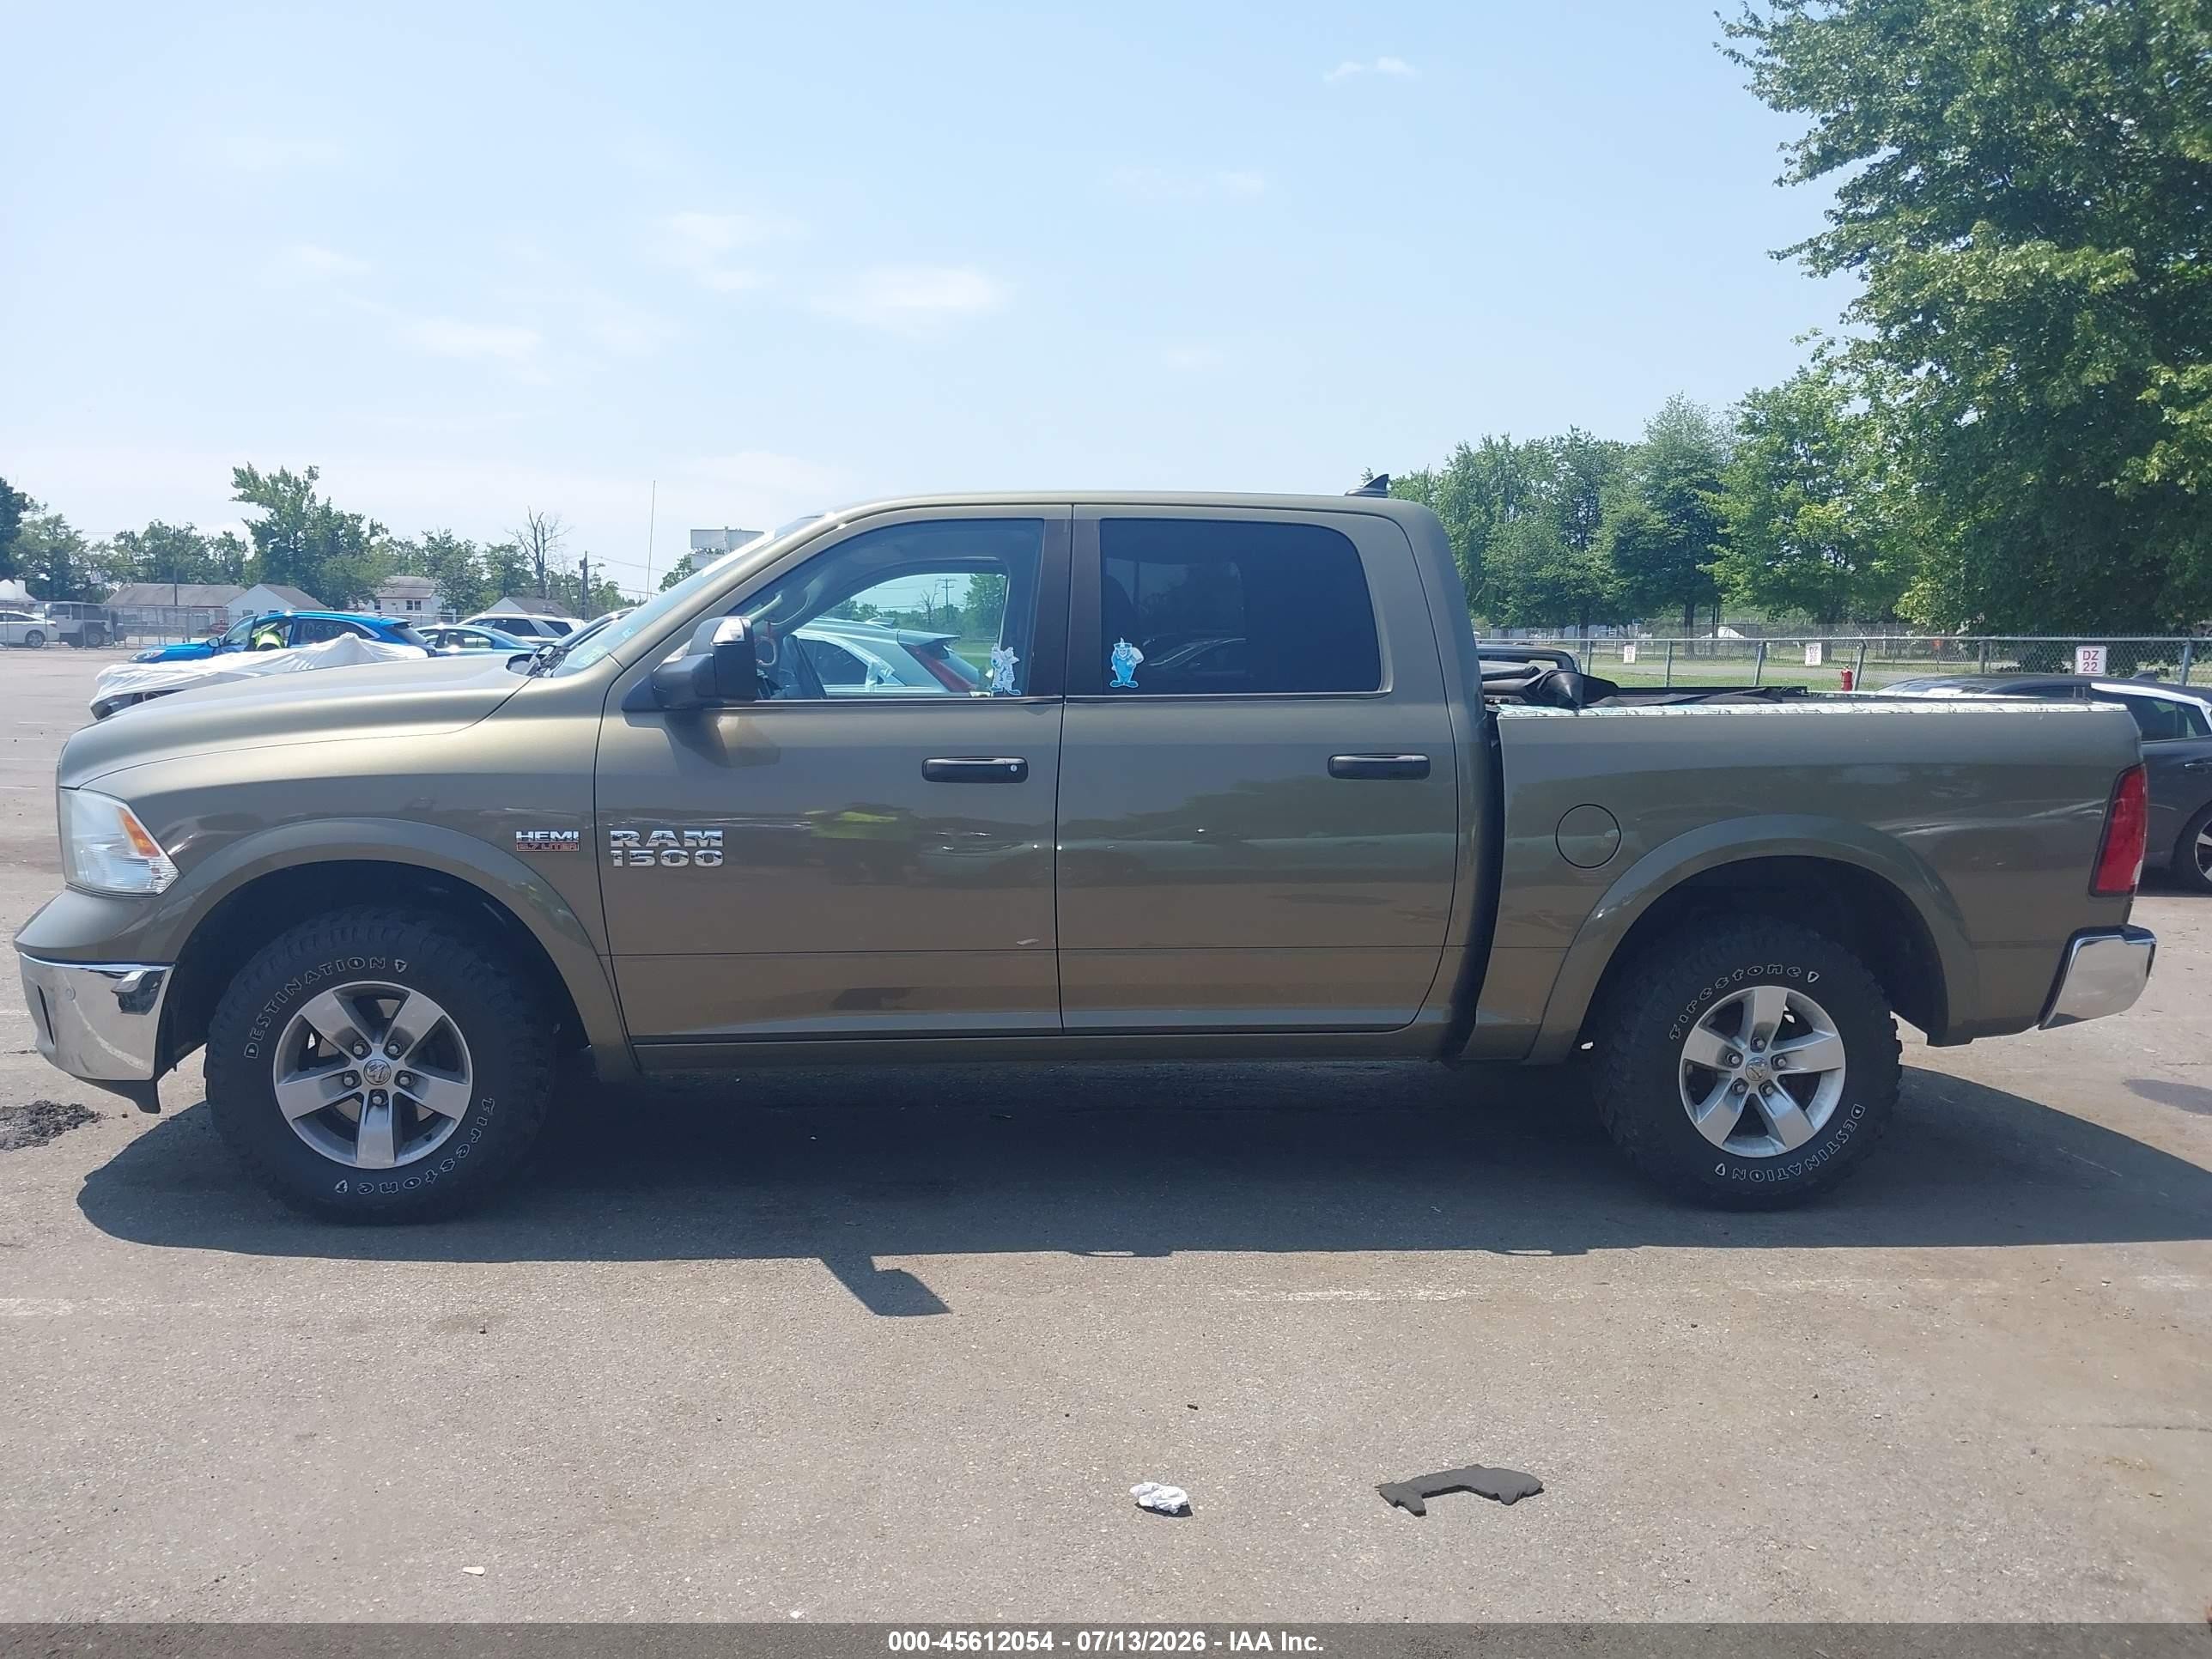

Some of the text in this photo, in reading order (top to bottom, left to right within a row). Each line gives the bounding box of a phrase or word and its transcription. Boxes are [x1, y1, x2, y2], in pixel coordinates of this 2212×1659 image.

[2082, 650, 2100, 660] DZ
[2082, 661, 2098, 672] 22
[515, 830, 580, 842] HEMI
[610, 830, 724, 848] RAM
[611, 849, 724, 867] 1500
[244, 956, 386, 1059] DESTINATION
[1732, 1103, 1866, 1182] DESTINATION
